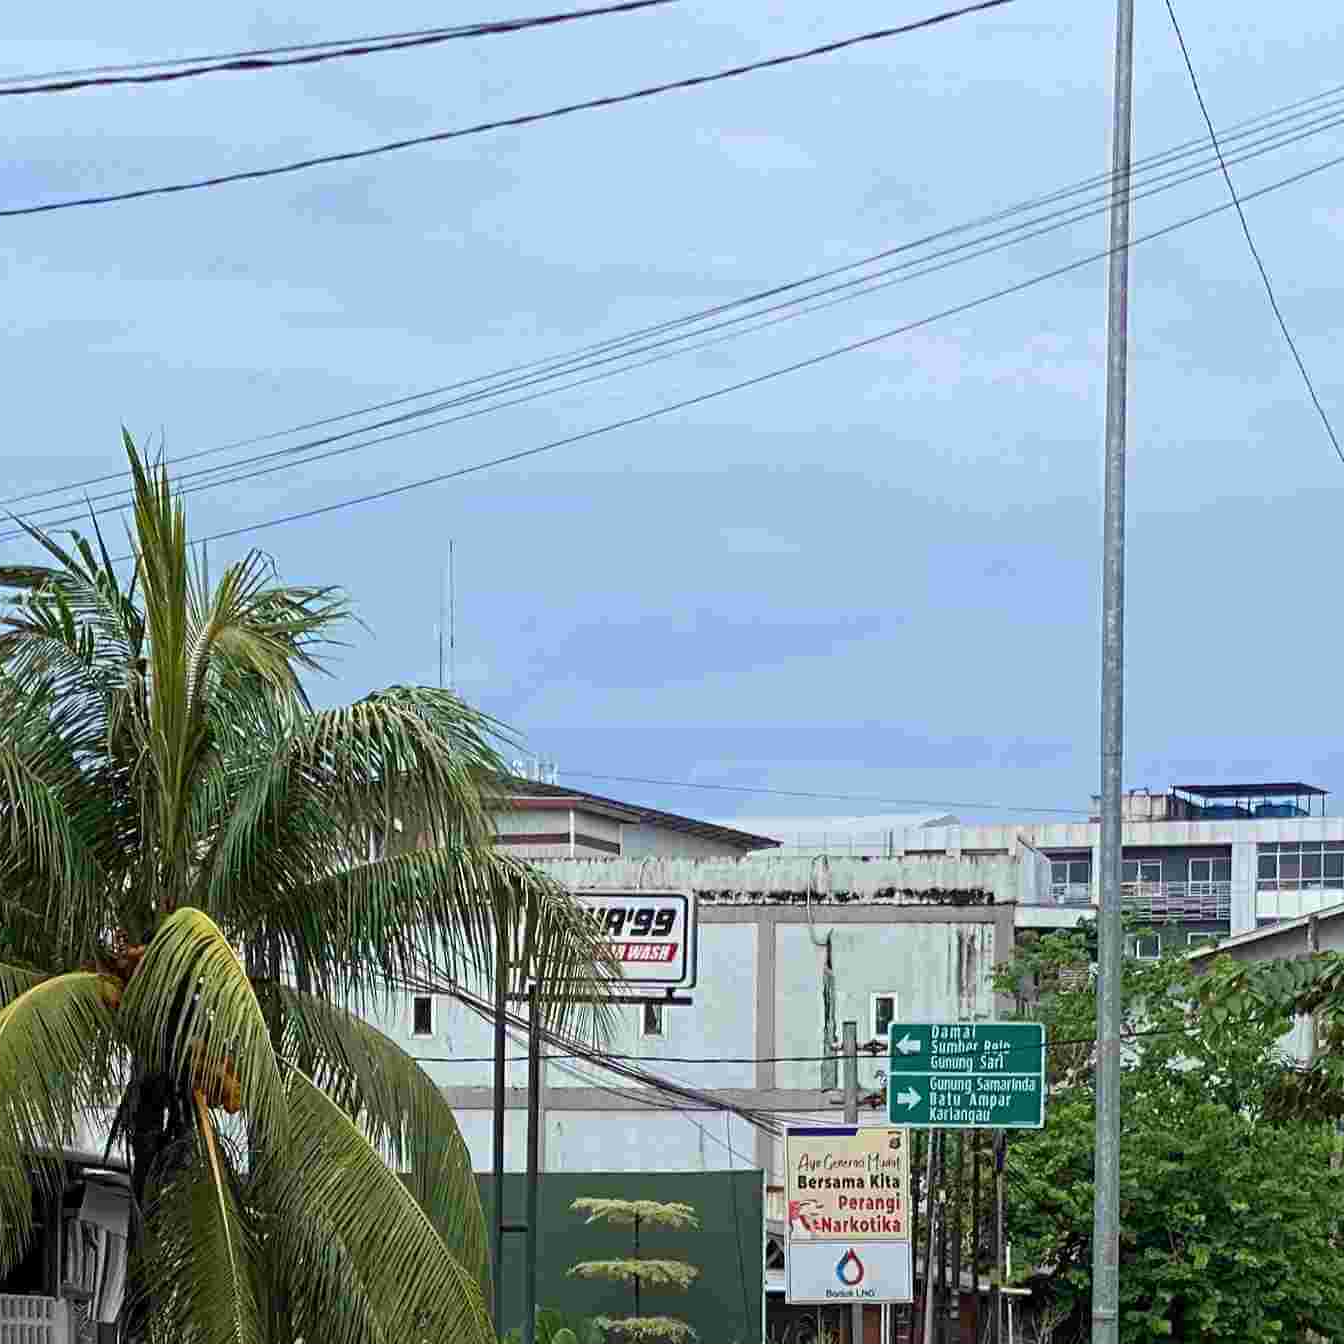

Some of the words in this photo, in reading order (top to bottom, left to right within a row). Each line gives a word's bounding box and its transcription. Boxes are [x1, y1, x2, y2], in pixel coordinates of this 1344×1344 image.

[626, 944, 671, 961] WASH
[930, 1055, 974, 1072] Gunung
[980, 1054, 1005, 1069] Sari
[929, 1077, 972, 1093] Gunung
[977, 1077, 1036, 1092] Samarinda
[929, 1093, 961, 1106] Batu
[969, 1093, 1011, 1109] Ampar
[798, 1174, 865, 1189] Bersama
[869, 1172, 900, 1189] Kita
[838, 1192, 900, 1214] Perangi
[821, 1215, 901, 1233] Narkotika
